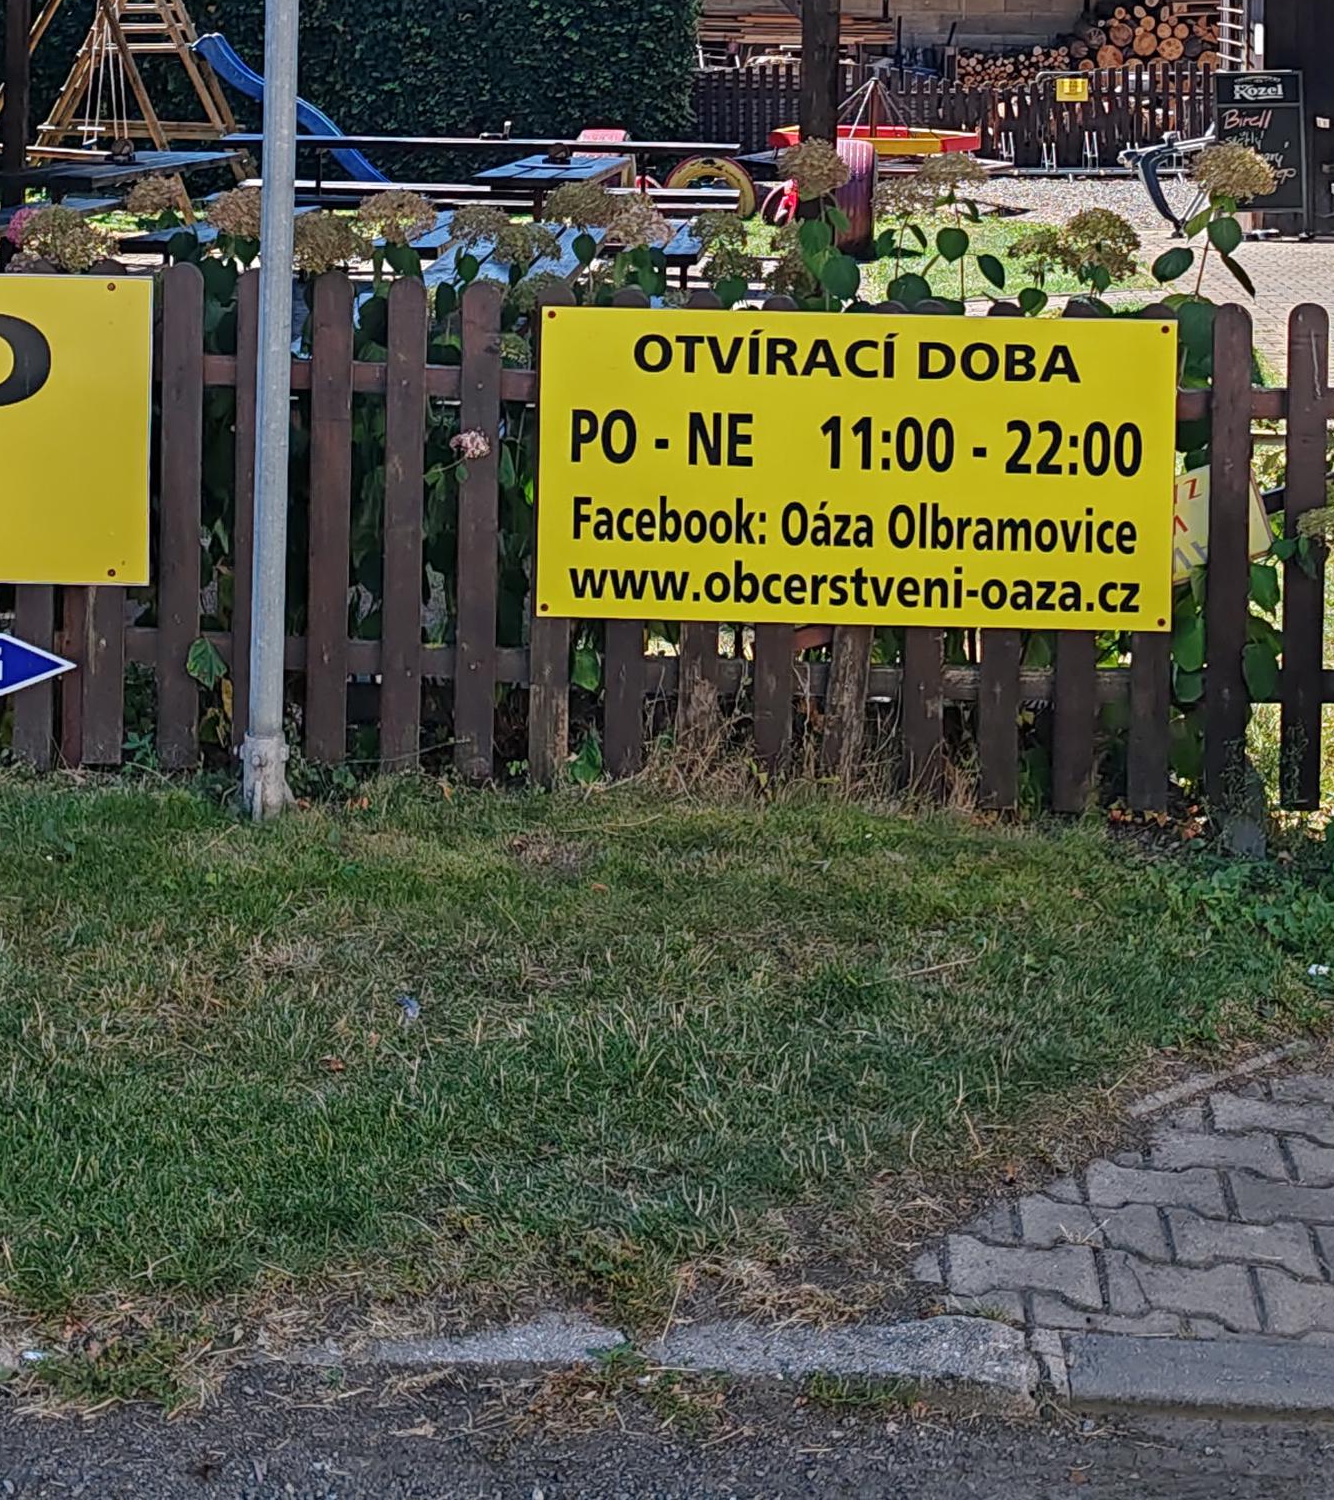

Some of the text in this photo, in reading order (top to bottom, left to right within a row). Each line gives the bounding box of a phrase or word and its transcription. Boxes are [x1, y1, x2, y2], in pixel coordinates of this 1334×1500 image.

[1233, 83, 1284, 101] Kozel
[633, 329, 1081, 384] OTVÍRACÍ DOBA
[570, 409, 1143, 478] PO - NE 11:00 - 22:00
[572, 496, 767, 545] Facebook:
[781, 501, 874, 548] Oáza
[888, 502, 1138, 555] Olbramovice
[569, 559, 1141, 614] www.obcerstveni-oaza.cz
